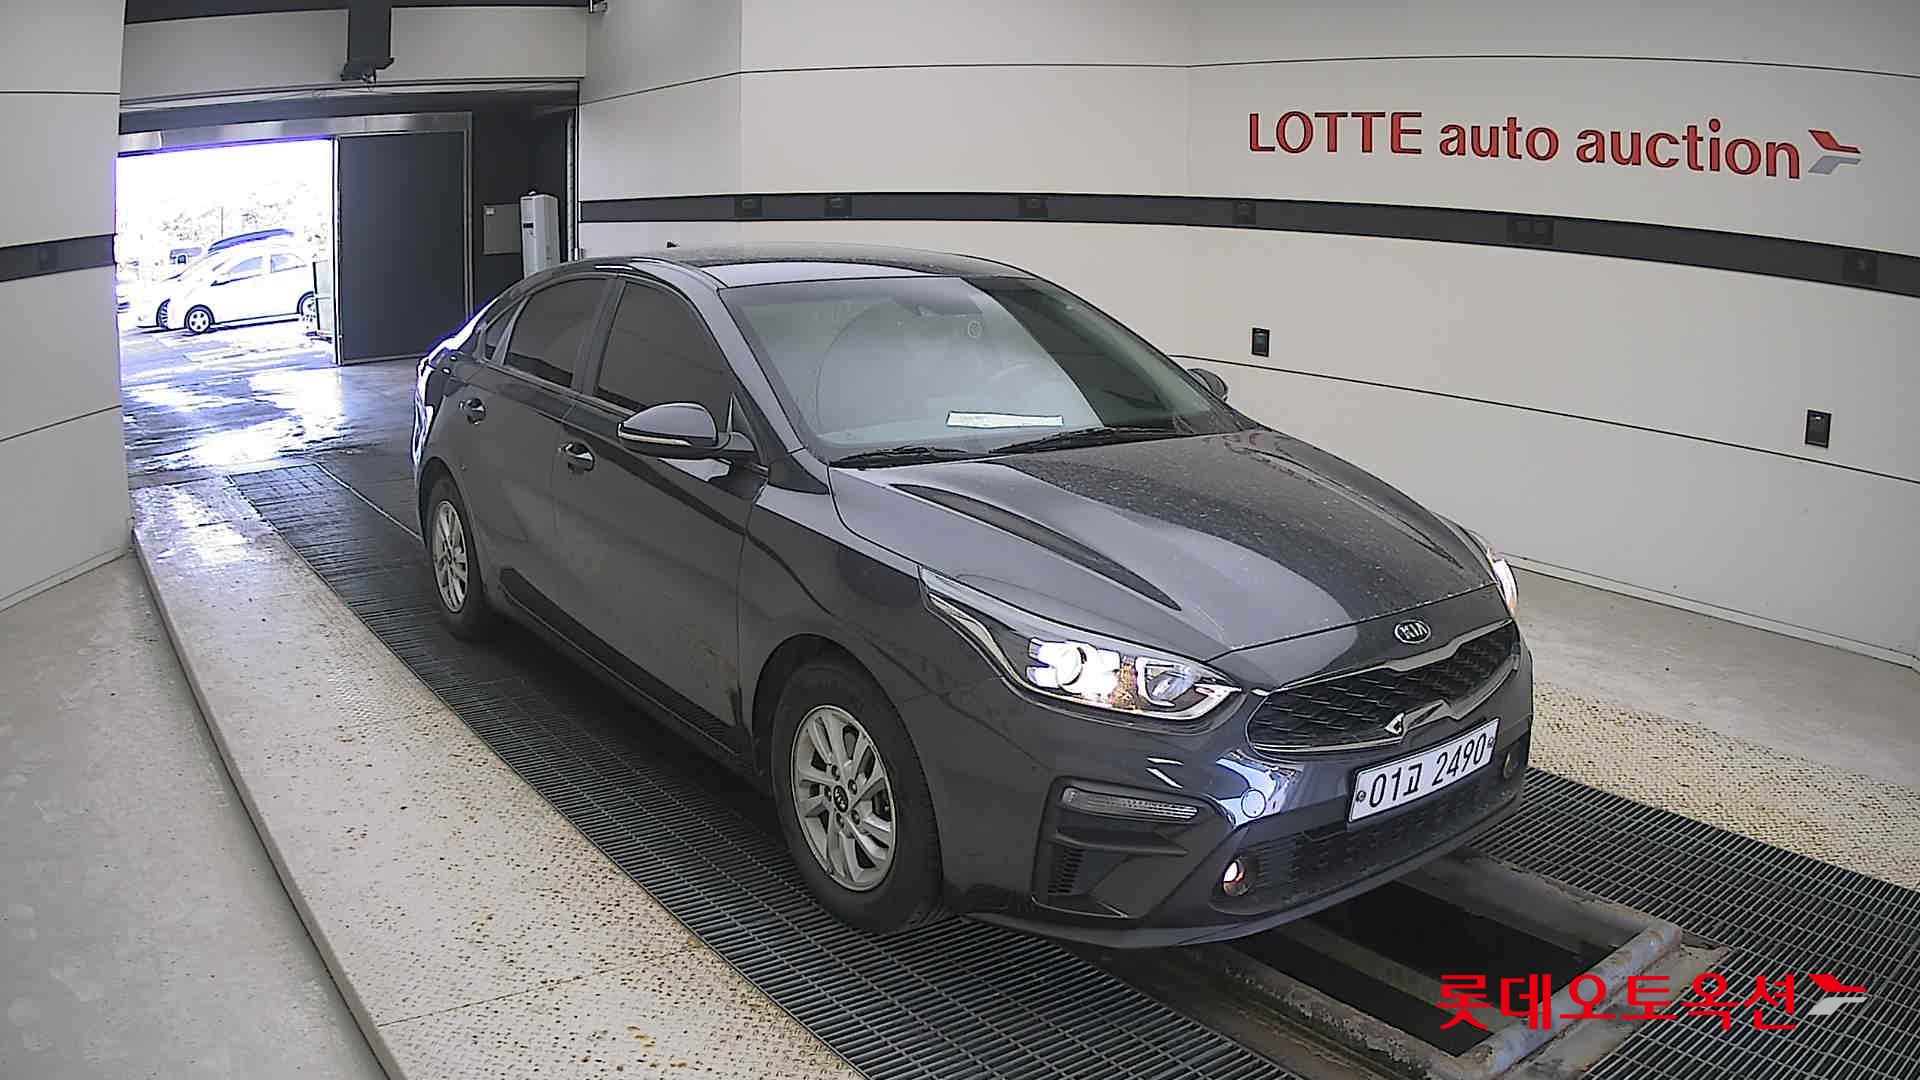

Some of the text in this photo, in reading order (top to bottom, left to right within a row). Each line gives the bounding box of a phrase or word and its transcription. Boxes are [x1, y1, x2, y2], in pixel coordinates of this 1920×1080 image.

[1248, 111, 1801, 180] LOTTE auto auction
[1399, 622, 1428, 640] KIA
[1431, 733, 1487, 787] 2490
